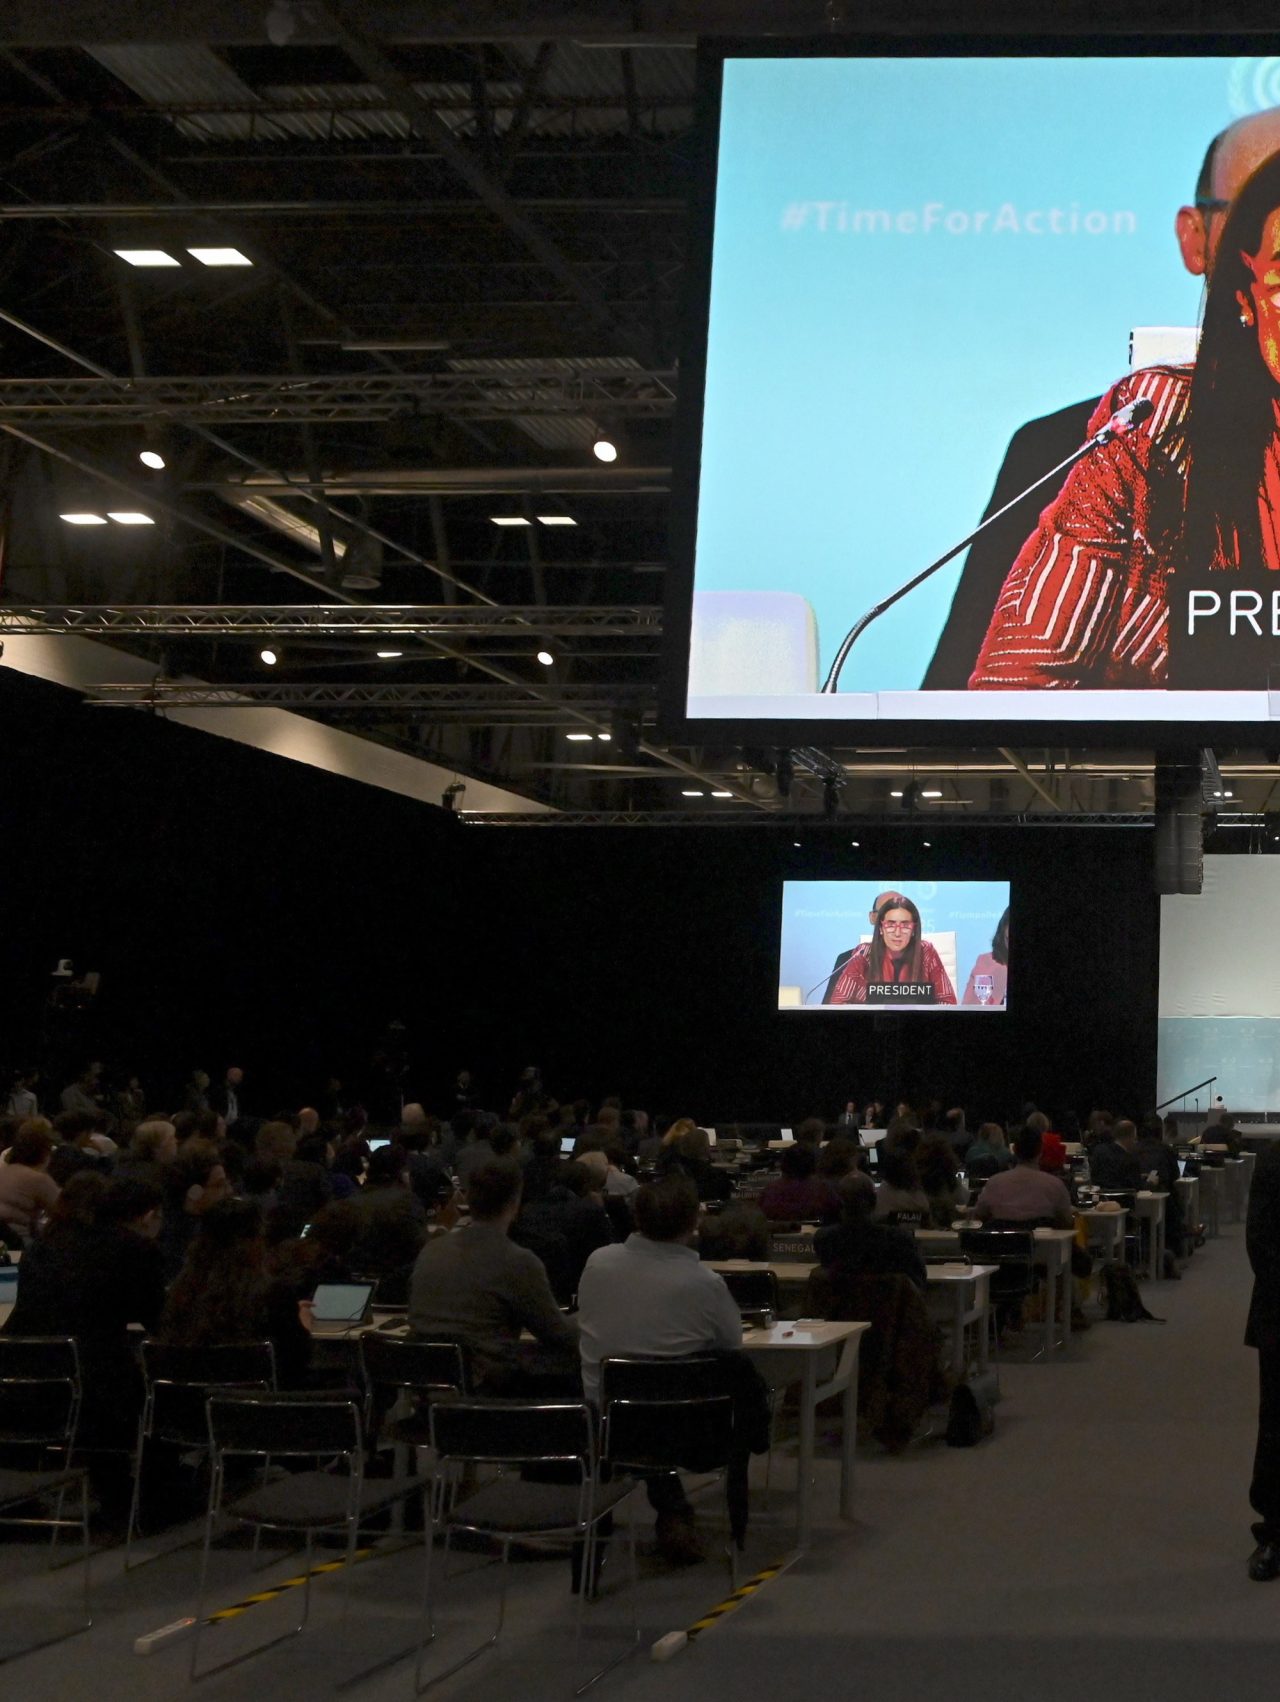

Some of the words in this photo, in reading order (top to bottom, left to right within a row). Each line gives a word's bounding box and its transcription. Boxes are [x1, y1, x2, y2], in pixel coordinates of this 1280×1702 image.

[782, 201, 1137, 235] #TimeForAction
[869, 985, 932, 996] PRESIDENT
[898, 1212, 922, 1221] PALAU
[773, 1243, 816, 1253] SENEGAL
